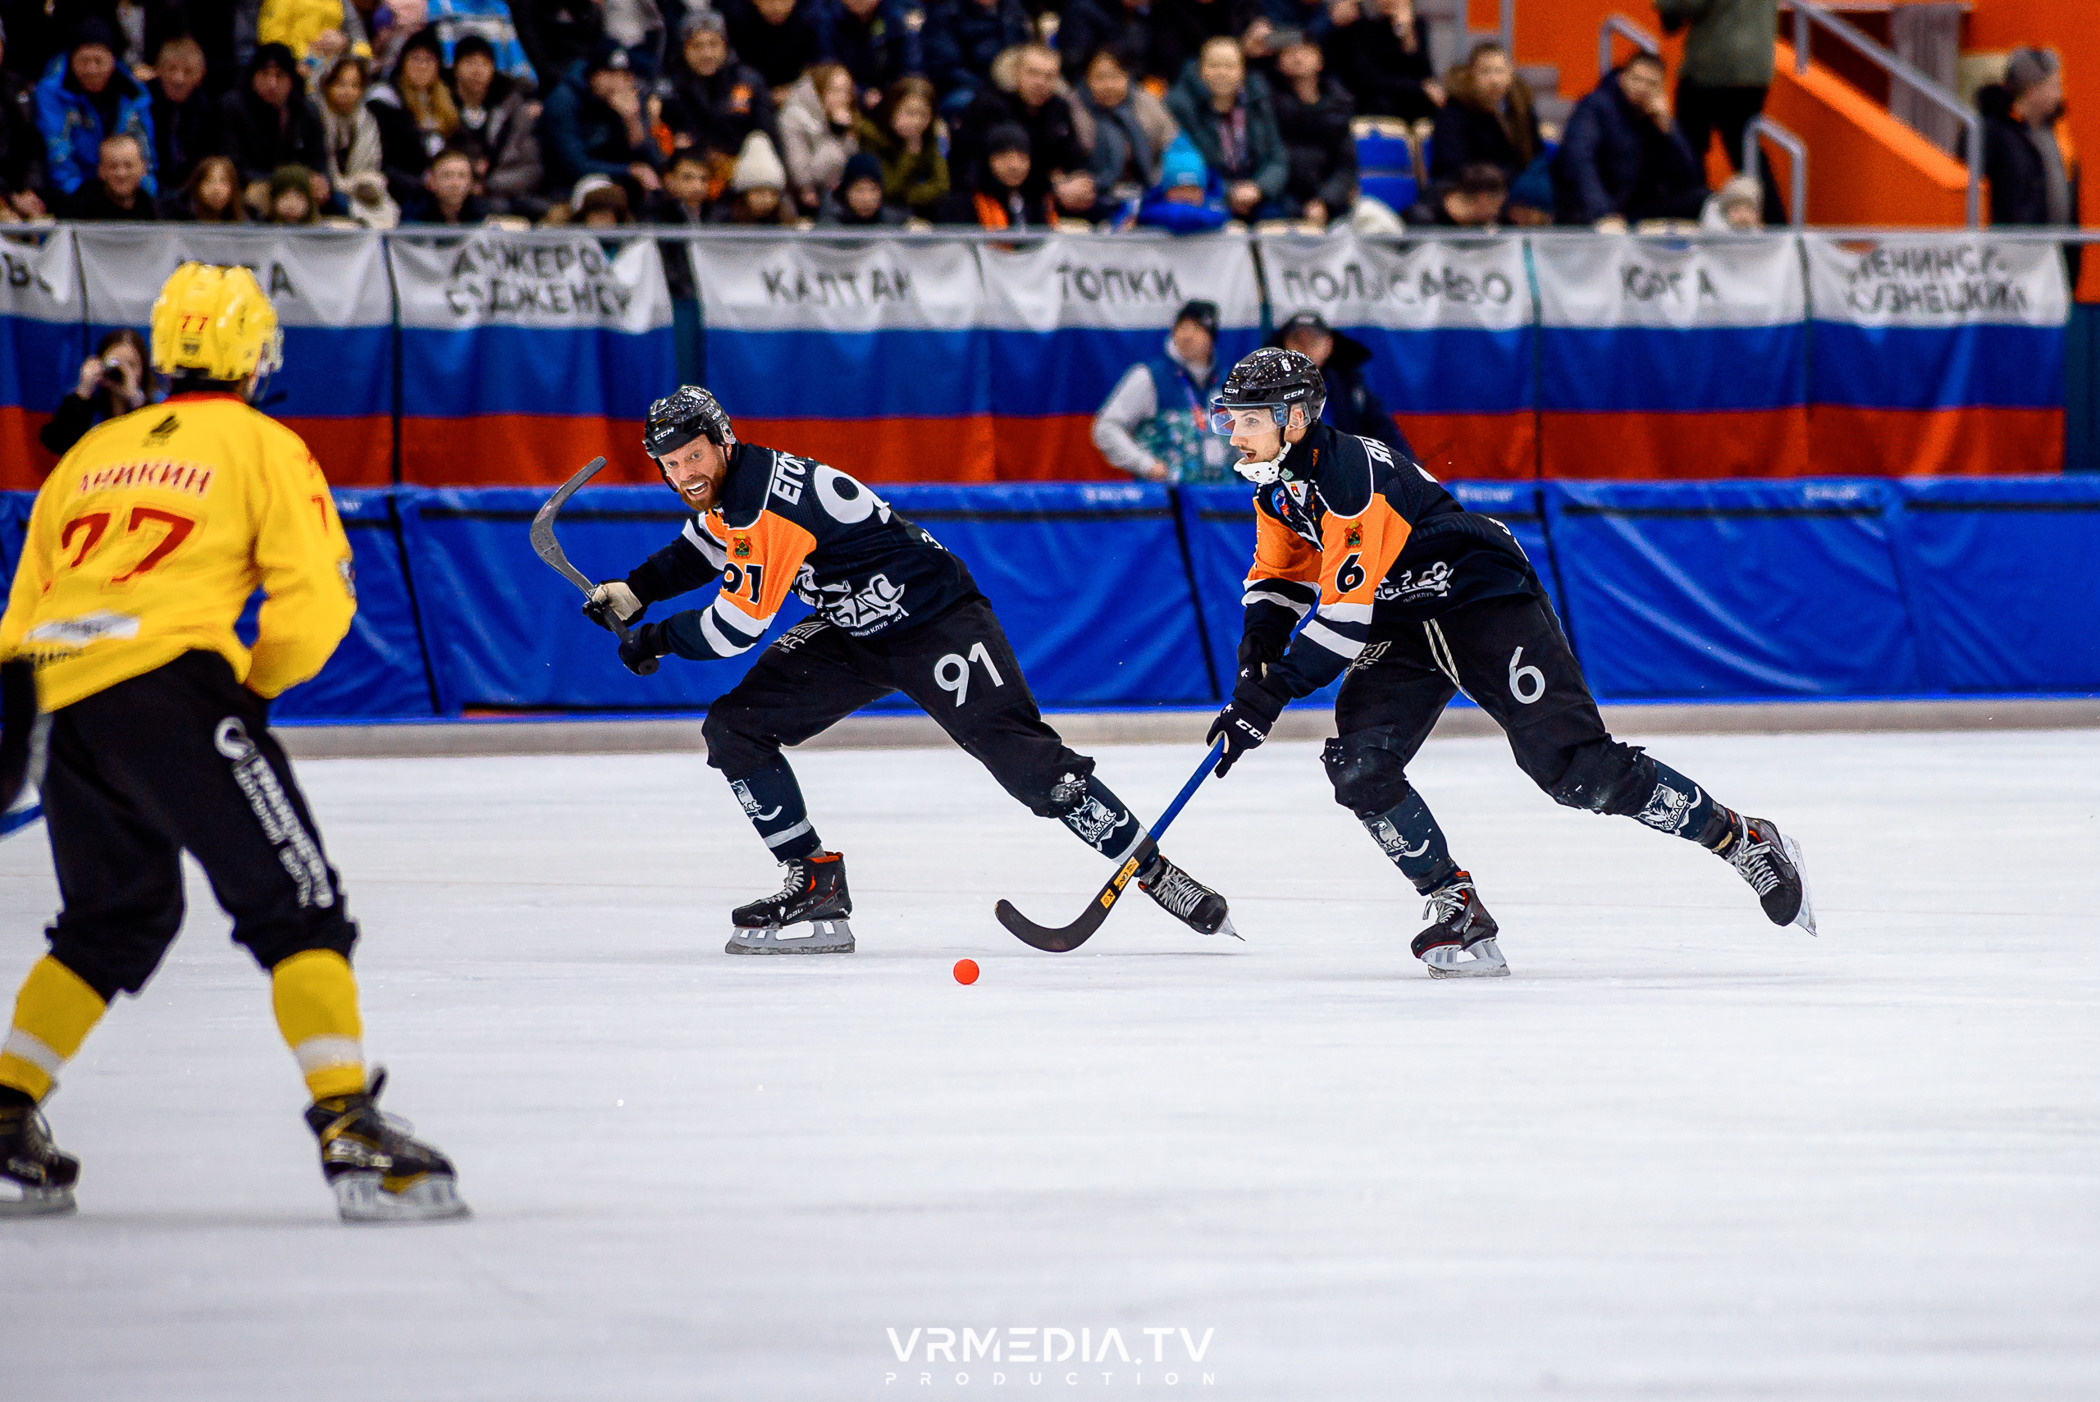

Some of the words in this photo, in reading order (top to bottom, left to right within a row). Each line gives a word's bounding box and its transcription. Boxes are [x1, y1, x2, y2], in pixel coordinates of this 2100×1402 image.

[1056, 262, 1182, 303] ТОПКИ
[181, 314, 209, 331] 77
[1281, 358, 1292, 372] 6
[1283, 388, 1305, 400] CCM
[654, 426, 675, 441] CCM
[79, 463, 211, 494] АНИКИН
[60, 507, 196, 583] 77
[721, 561, 764, 606] 91
[1336, 552, 1366, 593] 6
[934, 642, 1004, 707] 91
[1509, 646, 1545, 704] 6
[1235, 718, 1267, 742] CCM
